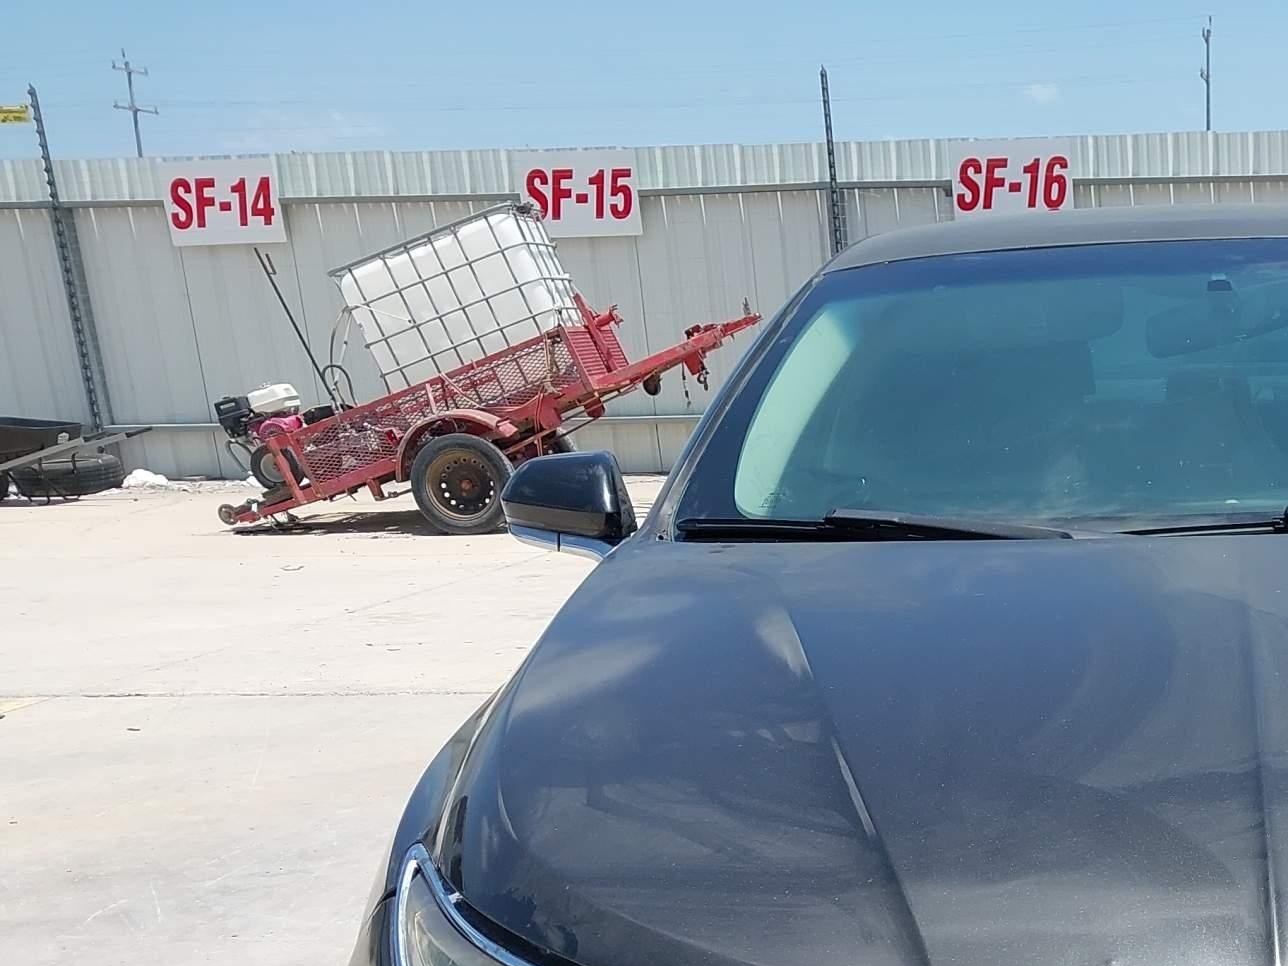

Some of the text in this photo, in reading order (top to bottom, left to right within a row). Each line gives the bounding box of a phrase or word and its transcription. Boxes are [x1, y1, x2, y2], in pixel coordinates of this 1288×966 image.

[170, 176, 275, 230] SF-14
[526, 168, 632, 220] SF-15
[956, 155, 1068, 211] SF-16
